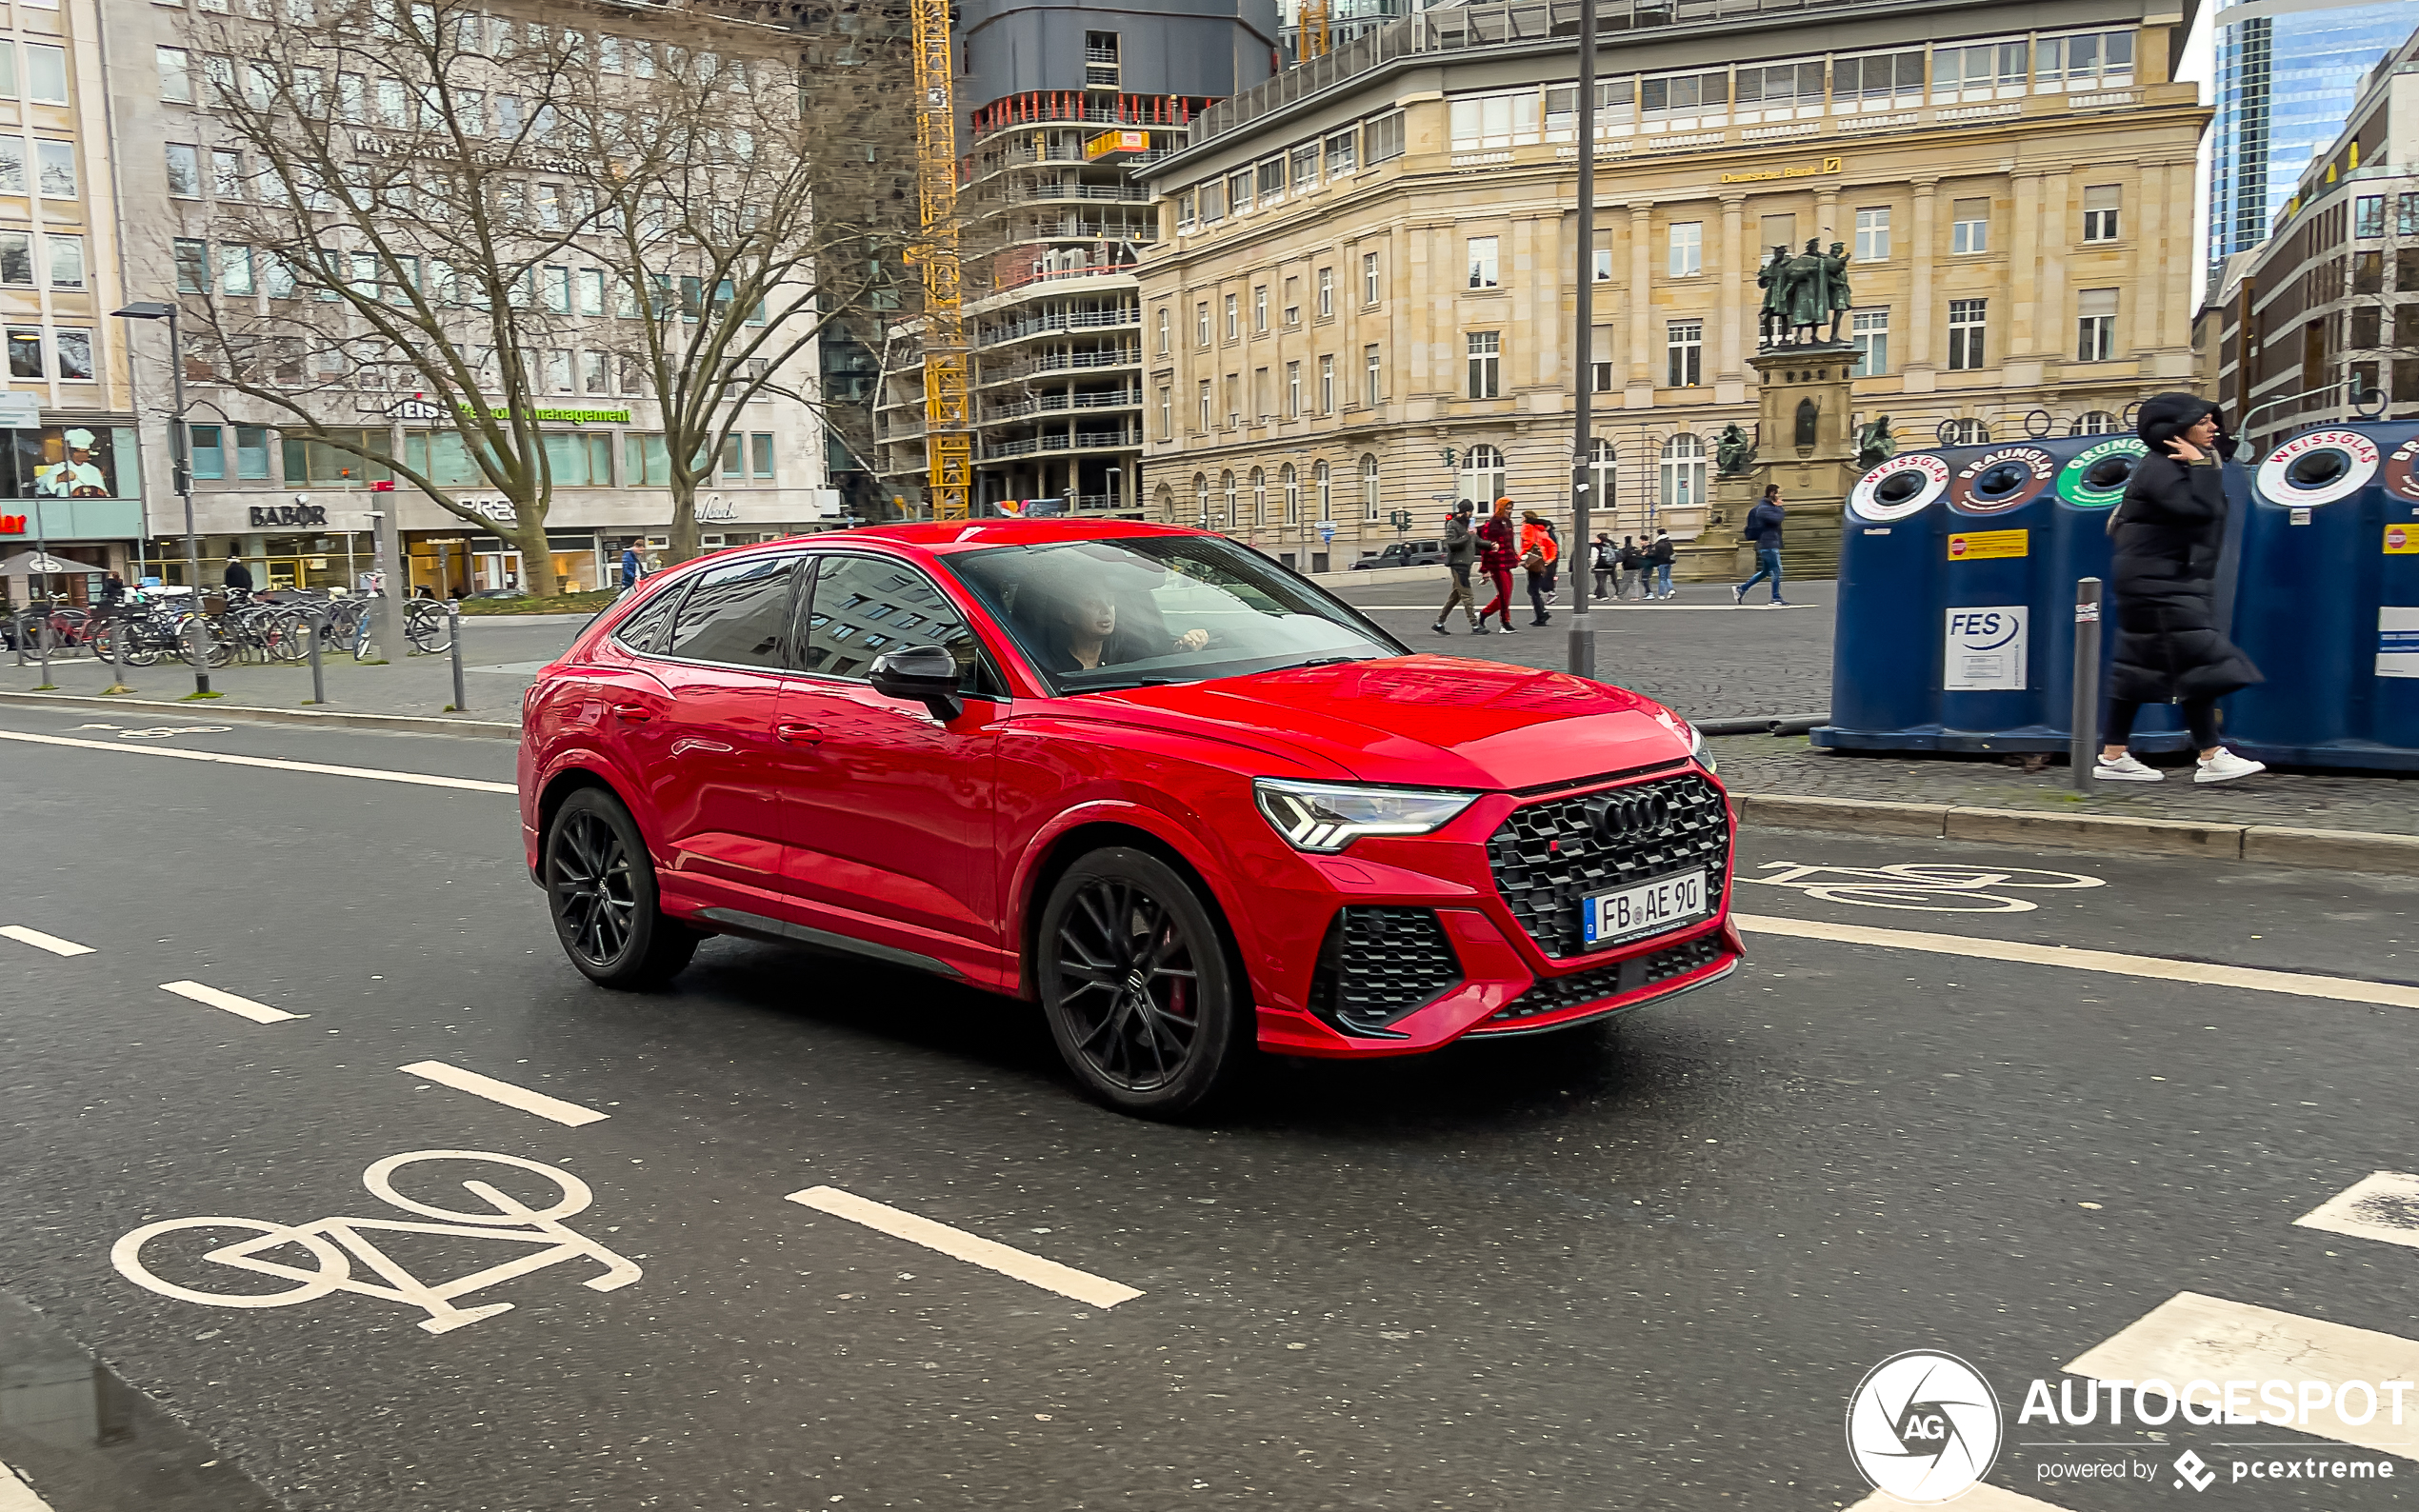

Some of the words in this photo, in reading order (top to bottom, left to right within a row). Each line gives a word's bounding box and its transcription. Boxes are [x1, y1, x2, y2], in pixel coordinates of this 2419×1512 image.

[2269, 433, 2378, 463] WEISSGLAS
[1864, 457, 1949, 483] WEISSGLAS
[1958, 448, 2053, 480] BRAUNGLAS
[249, 506, 330, 527] BABOR
[1949, 612, 2002, 636] FES
[1603, 895, 1630, 932] FB
[1646, 885, 1670, 922] AE
[1675, 878, 1697, 912] 90
